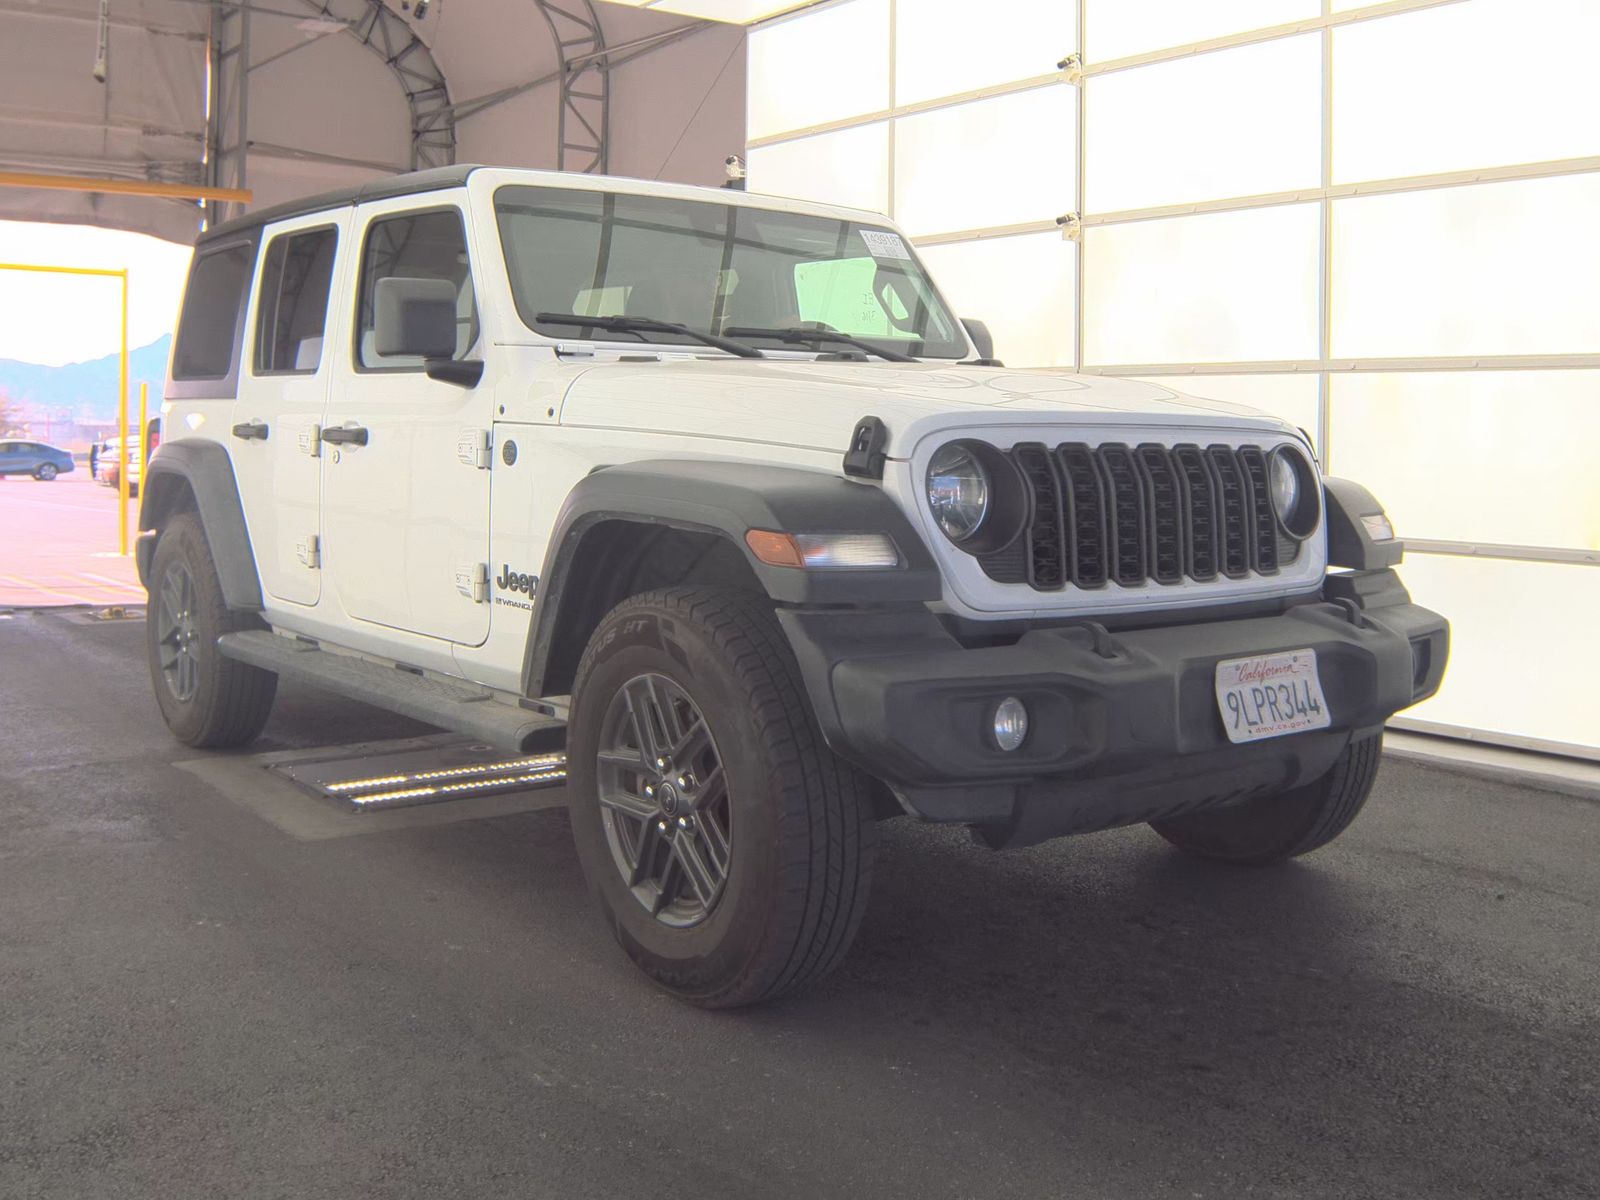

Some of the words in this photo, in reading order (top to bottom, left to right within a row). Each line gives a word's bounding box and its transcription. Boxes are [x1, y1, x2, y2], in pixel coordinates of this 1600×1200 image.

[496, 563, 539, 601] Jeep
[1238, 660, 1300, 682] California
[1226, 680, 1321, 730] 9LPR344
[1255, 720, 1307, 734] dmv.ca.gov
